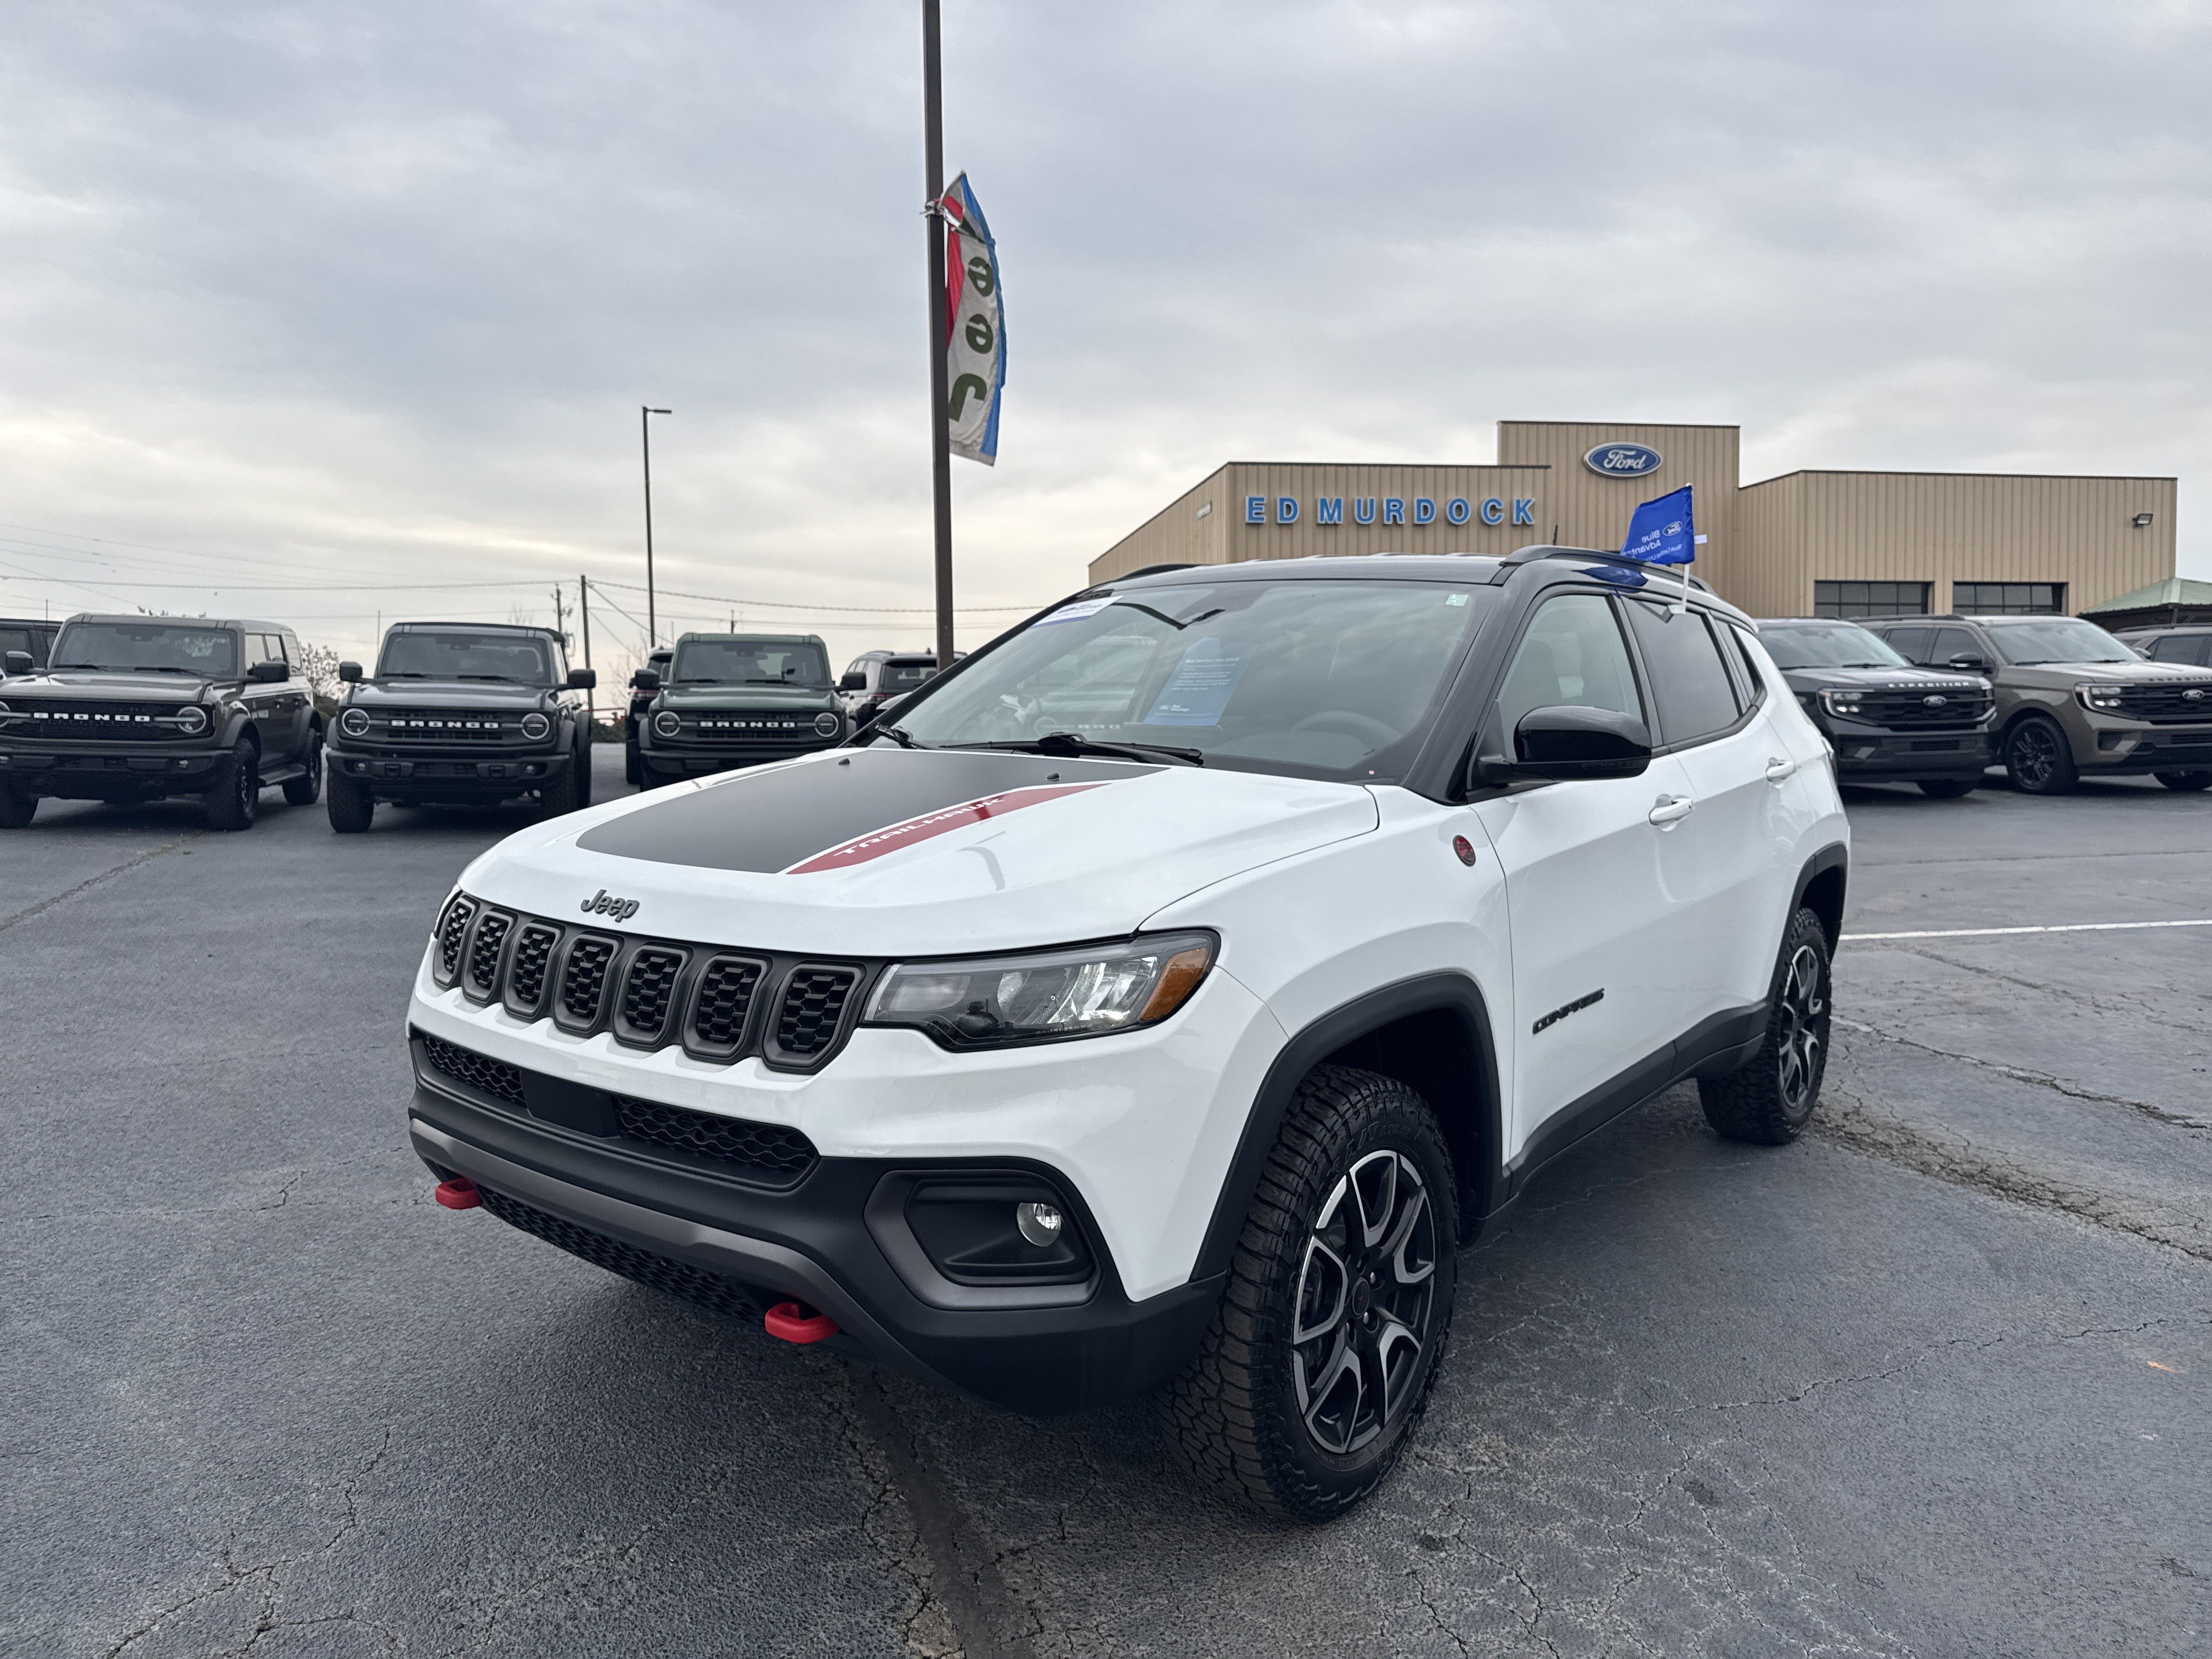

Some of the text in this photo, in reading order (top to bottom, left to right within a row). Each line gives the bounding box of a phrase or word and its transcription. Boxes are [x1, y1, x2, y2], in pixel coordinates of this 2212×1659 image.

[948, 256, 994, 421] Jee
[1603, 449, 1646, 470] Ford
[1245, 496, 1536, 526] ED MURDOCK
[33, 712, 150, 722] BRONCO
[391, 720, 499, 729] BRONCO
[833, 798, 1005, 856] TRAILHAWK
[580, 889, 640, 923] Jeep
